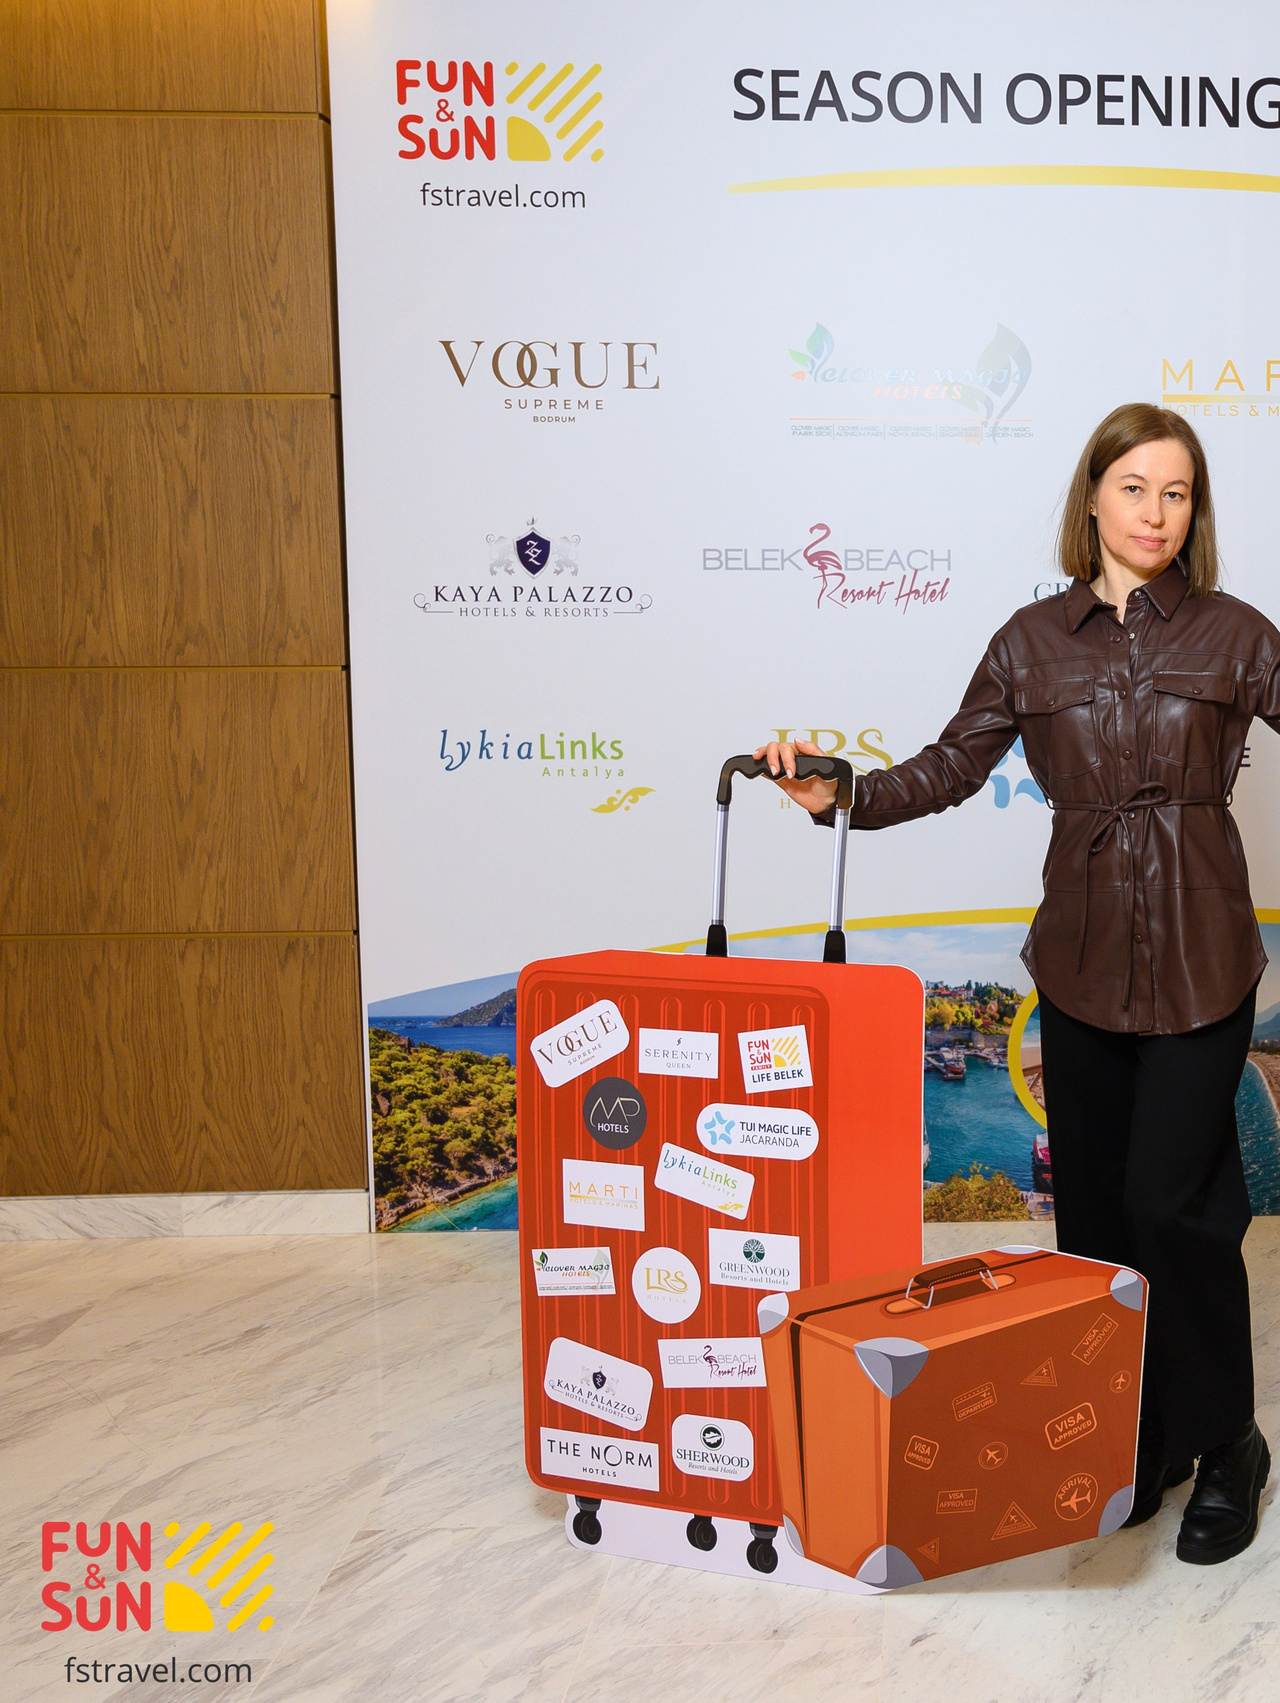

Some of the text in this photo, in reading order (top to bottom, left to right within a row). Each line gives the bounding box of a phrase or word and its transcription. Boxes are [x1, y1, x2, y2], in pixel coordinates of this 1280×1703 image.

[396, 60, 494, 107] FUN
[732, 67, 982, 125] SEASON
[436, 98, 455, 122] &
[397, 114, 496, 161] SUN
[420, 182, 586, 208] fstravel.com
[438, 340, 660, 390] VOGUE
[504, 398, 604, 410] SUPREME
[1249, 404, 1260, 417] &
[533, 415, 576, 423] BODRUM
[702, 548, 952, 572] BELEK BEACH
[433, 586, 634, 603] KAYA PALAZZO
[813, 569, 950, 615] Resort Hotel
[459, 606, 609, 617] HOTELS & RESORTS
[542, 766, 624, 779] Antalya
[537, 1010, 617, 1065] VOGUE
[747, 1039, 770, 1053] FUN
[567, 1042, 603, 1066] SUPREME
[644, 1048, 713, 1062] SERENITY
[749, 1051, 771, 1065] SUN
[752, 1069, 804, 1084] LIFE BELEK
[597, 1122, 630, 1134] HOTELS
[739, 1121, 812, 1136] TUI MAGIC LIFE
[739, 1133, 800, 1148] JACARANDA
[568, 1180, 638, 1200] MARTI
[569, 1198, 597, 1206] HOTELS
[605, 1201, 639, 1210] MARINAS
[719, 1261, 790, 1278] GREENWOOD
[643, 1267, 689, 1294] LRS
[720, 1272, 789, 1286] Resorts and Hotels
[646, 1294, 687, 1303] HOTELS
[1082, 1321, 1113, 1359] APPROVED
[1083, 1328, 1100, 1347] VISA
[668, 1354, 757, 1365] BELEK BEACH
[556, 1379, 635, 1416] KAYA PALAZZO
[565, 1391, 588, 1404] HOTELS
[597, 1404, 624, 1418] RESORTS
[958, 1398, 995, 1419] DEPARTURE
[1055, 1412, 1085, 1433] VISA
[1054, 1419, 1093, 1445] APPROVED
[547, 1439, 652, 1468] THE NORM
[914, 1441, 931, 1456] VISA
[676, 1448, 750, 1468] SHERWOOD
[907, 1452, 931, 1465] APPROVED
[582, 1466, 617, 1478] HOTELS
[688, 1461, 738, 1475] Resorts and Hotels
[948, 1492, 964, 1500] VISA
[1057, 1476, 1092, 1500] ARRIVAL
[939, 1500, 974, 1508] APPROVED
